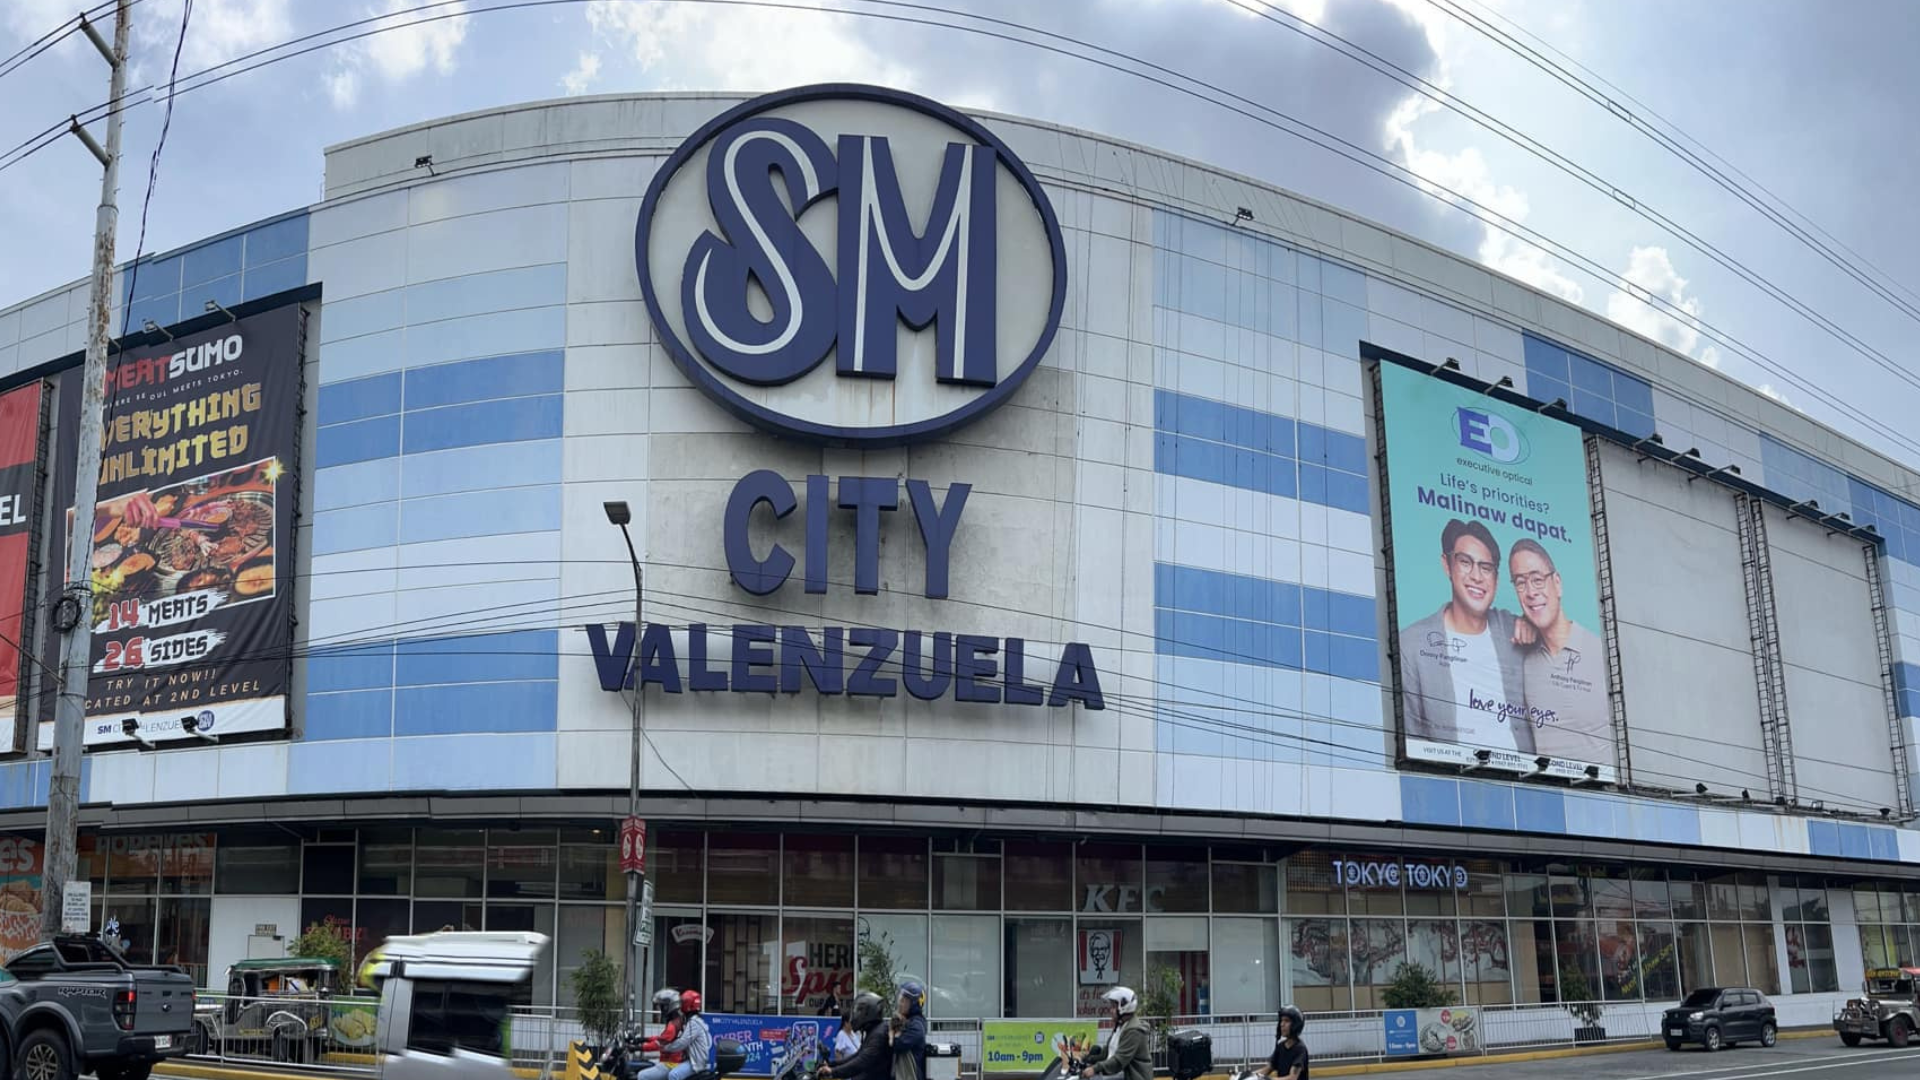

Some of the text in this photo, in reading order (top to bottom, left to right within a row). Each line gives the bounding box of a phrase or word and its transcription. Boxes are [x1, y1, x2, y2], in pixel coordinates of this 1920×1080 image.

[681, 117, 997, 387] SM
[104, 334, 243, 397] MEATSUMO
[100, 382, 261, 451] VERYTHING
[1456, 457, 1533, 486] executive optical
[1440, 472, 1550, 515] Life's priorities?
[1417, 485, 1572, 543] Malinaw dapat.
[723, 469, 972, 599] CITY
[109, 594, 208, 630] 14 MEATS
[104, 635, 208, 671] 26 SIDES
[585, 621, 1106, 710] VALENZUELA
[85, 680, 260, 710] CATED AT 2ND LEVEL
[107, 668, 216, 691] TRY IT NOW!!
[1469, 688, 1495, 711] love
[1497, 702, 1526, 723] your
[97, 725, 112, 734] SM
[1332, 861, 1468, 888] TOKYO TOKYO
[1083, 884, 1166, 912] KFC
[809, 943, 855, 968] HER
[58, 986, 108, 999] RAPTOR
[988, 1051, 1015, 1061] 10am
[1022, 1050, 1043, 1063] 9pm
